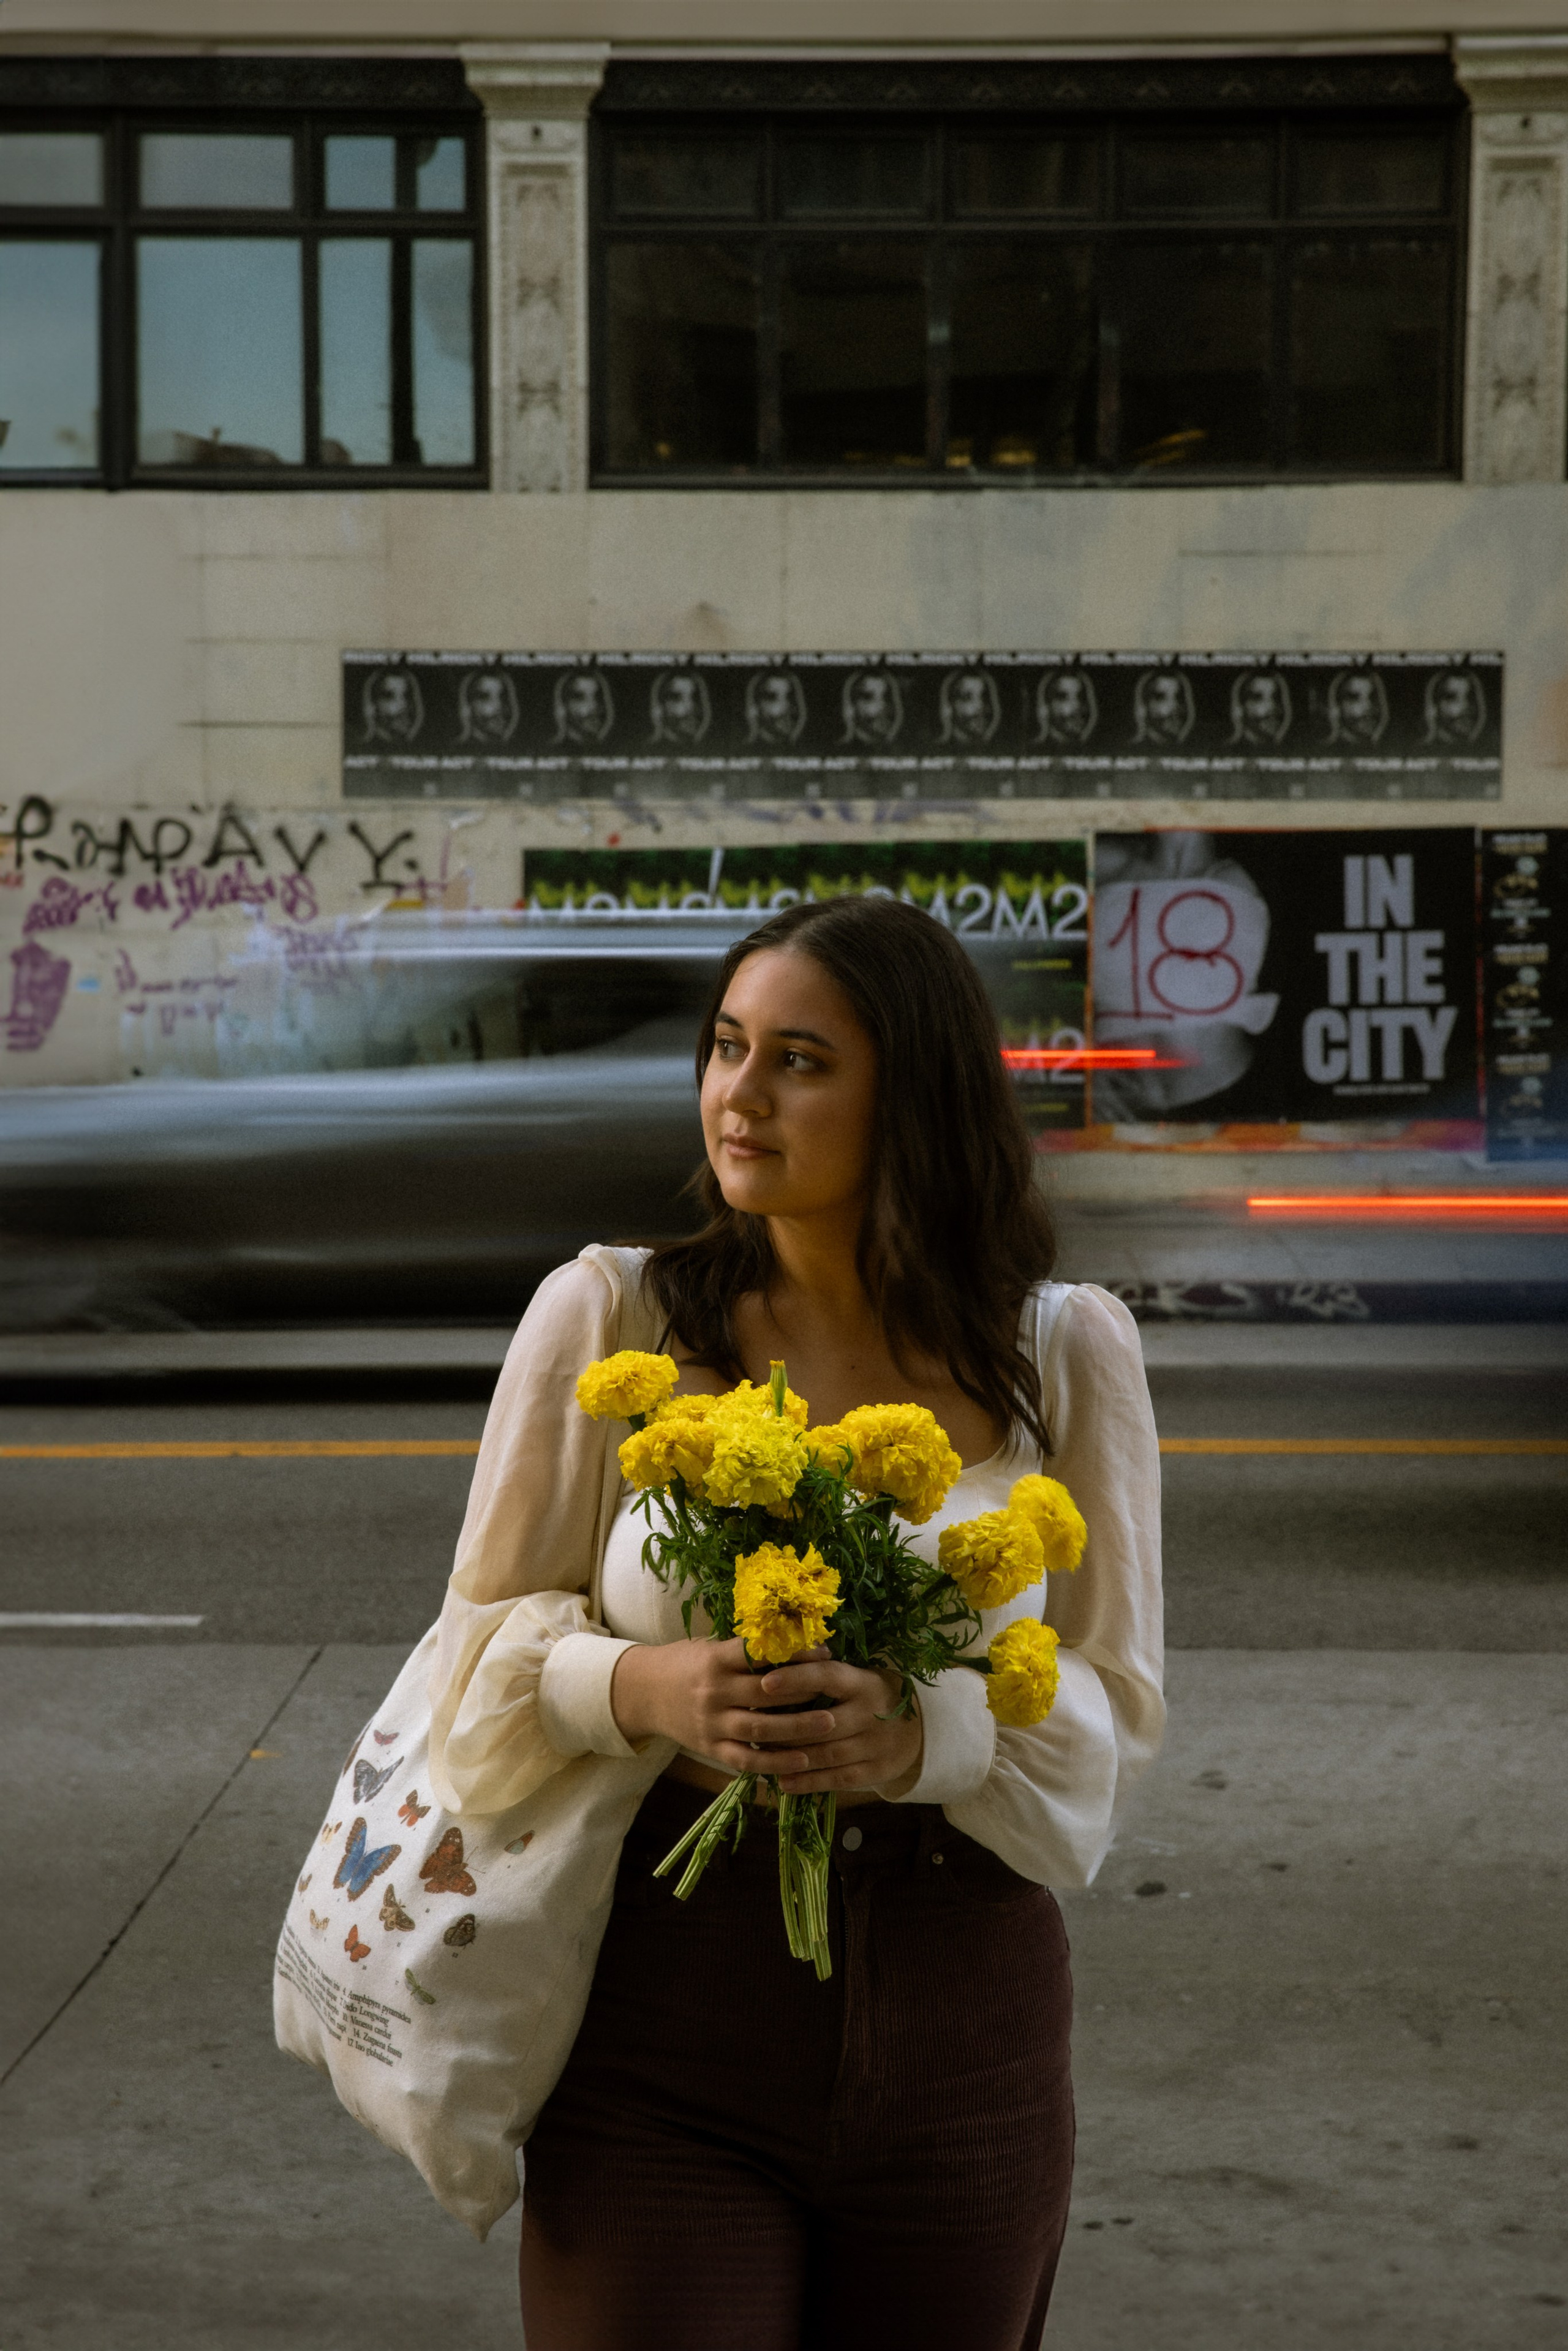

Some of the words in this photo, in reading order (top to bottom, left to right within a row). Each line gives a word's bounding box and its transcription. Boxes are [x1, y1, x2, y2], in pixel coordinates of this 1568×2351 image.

[1343, 854, 1415, 929] IN
[1095, 886, 1245, 1021] 18
[1314, 929, 1446, 1006] THE
[1302, 1006, 1459, 1084] CITY
[360, 2006, 389, 2028] Longwing
